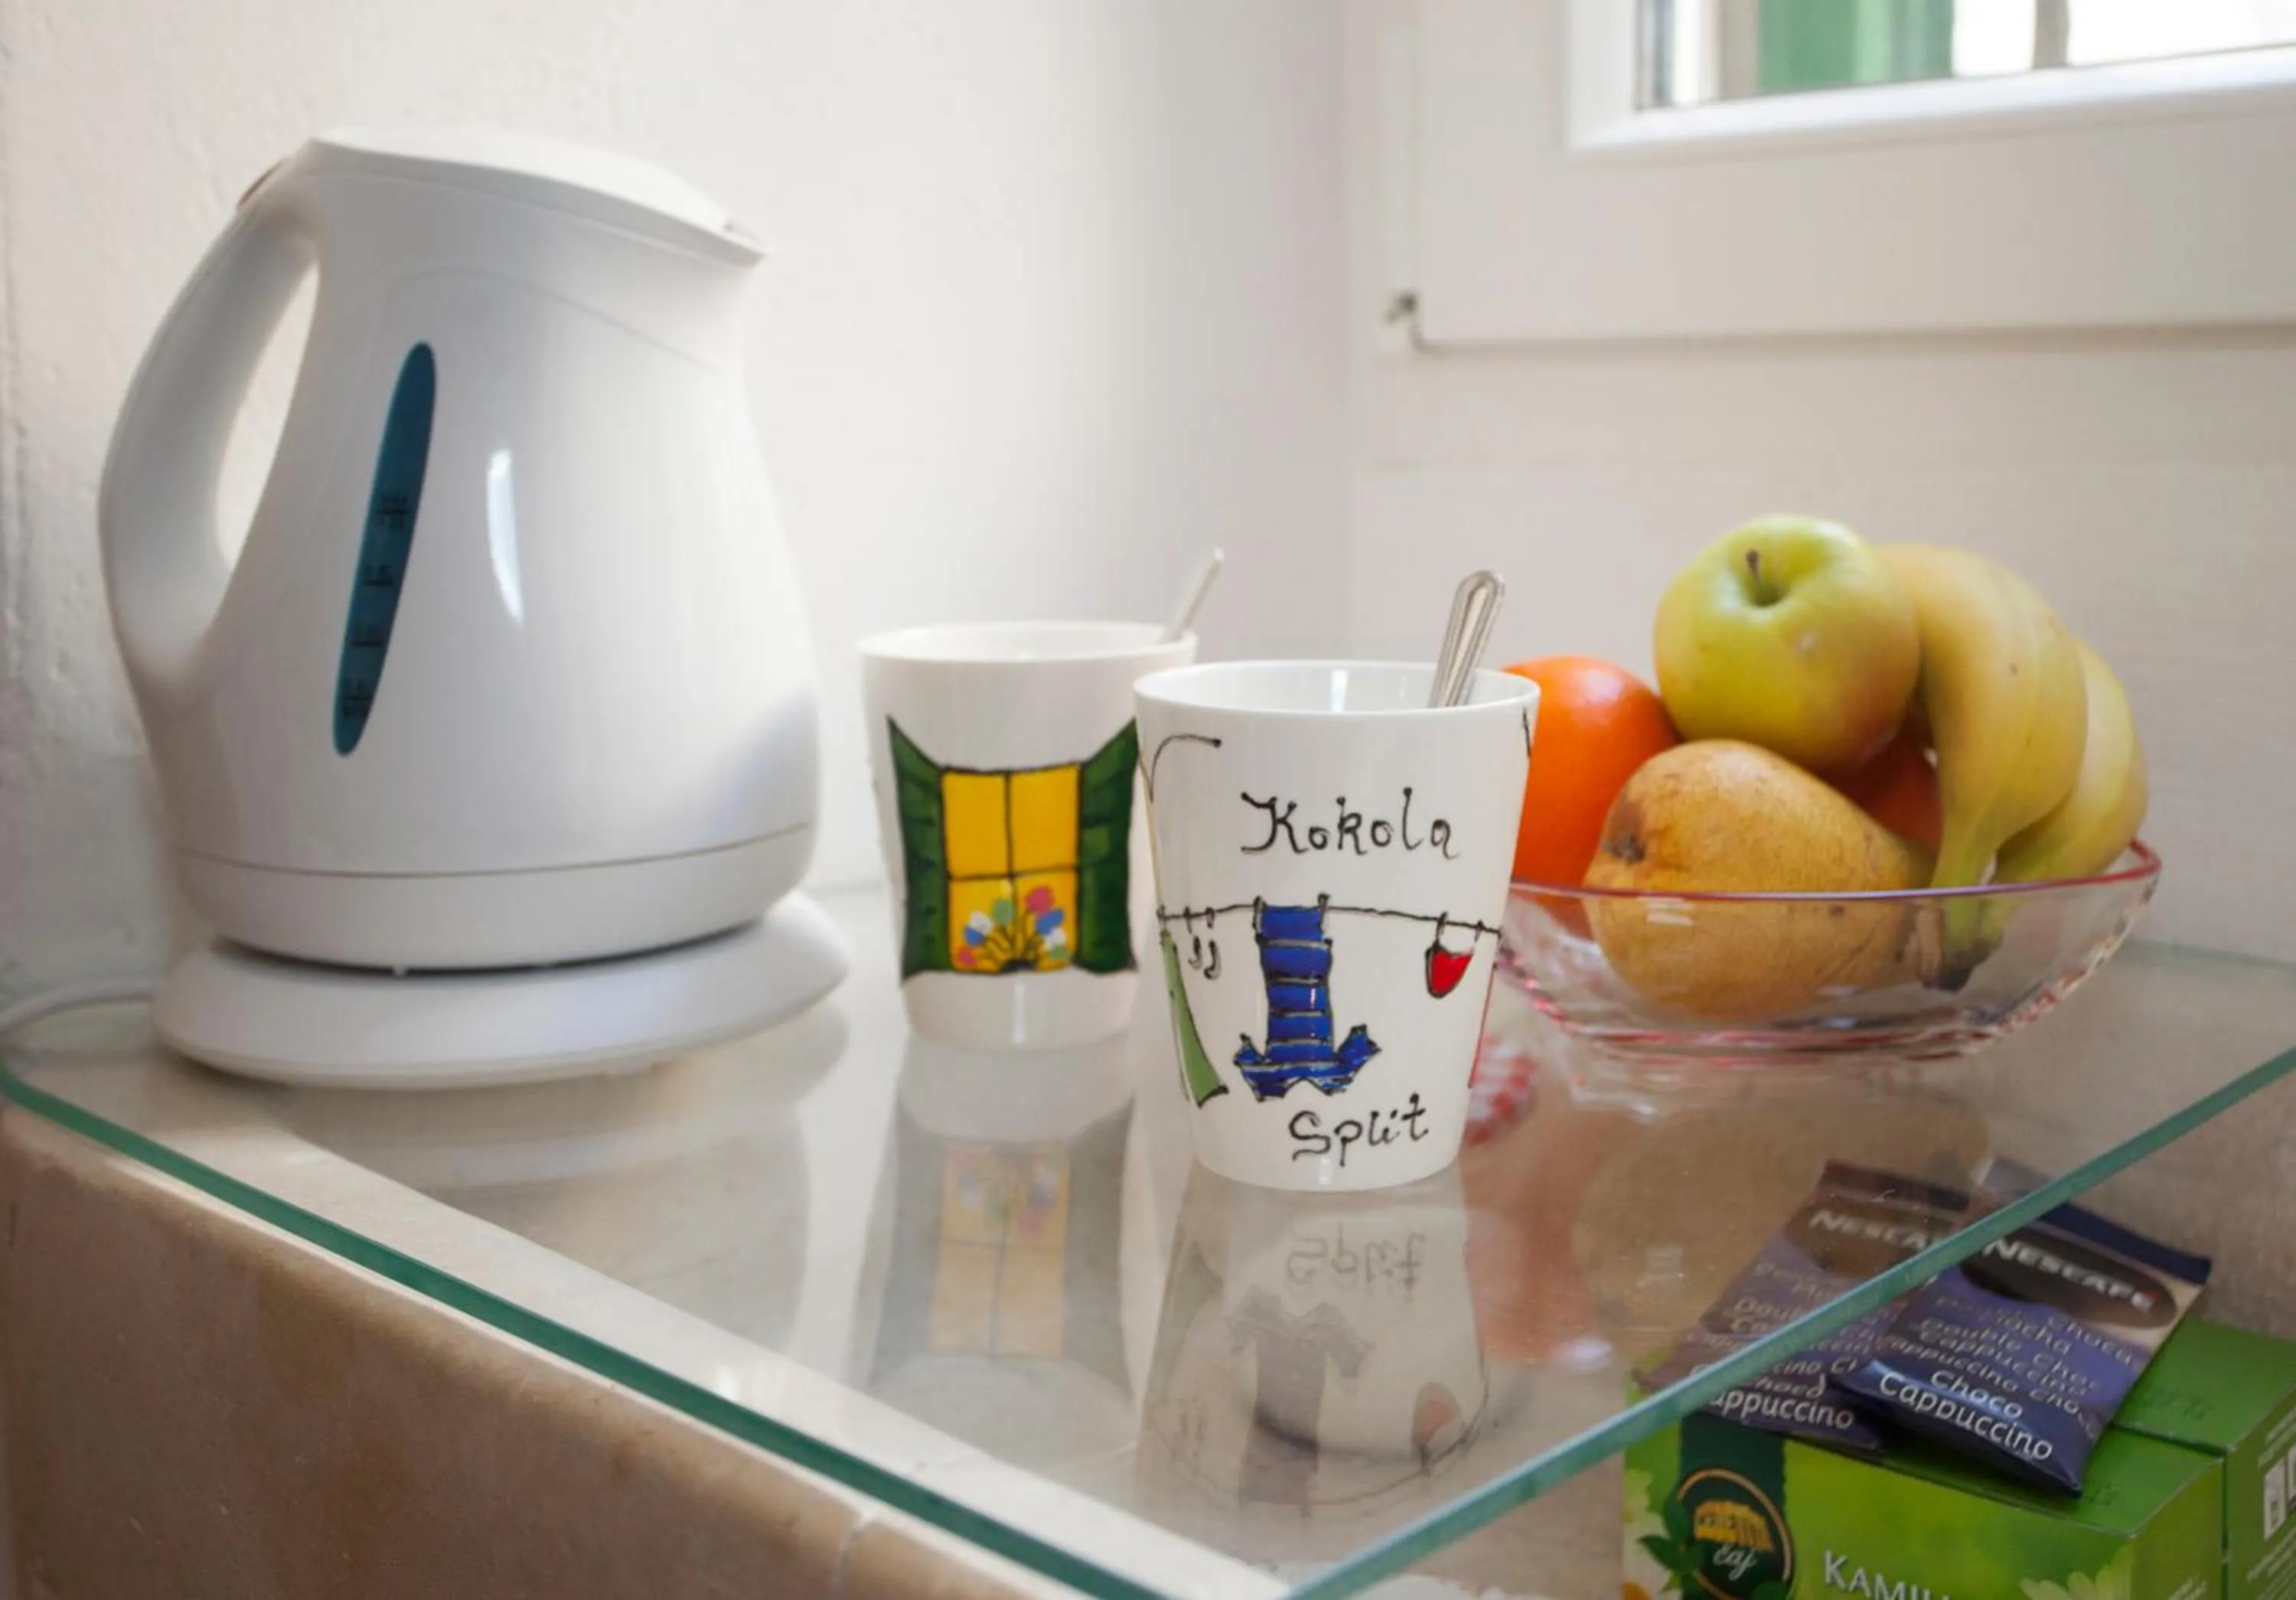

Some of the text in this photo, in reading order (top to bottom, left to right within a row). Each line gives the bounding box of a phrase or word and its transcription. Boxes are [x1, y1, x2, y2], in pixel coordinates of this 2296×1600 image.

[1241, 786, 1461, 860] Kokola
[1289, 1092, 1429, 1167] Split
[1879, 1370, 2053, 1460] Cappuccino
[1929, 1370, 2024, 1418] Choco
[1824, 1548, 1949, 1600] KAM
